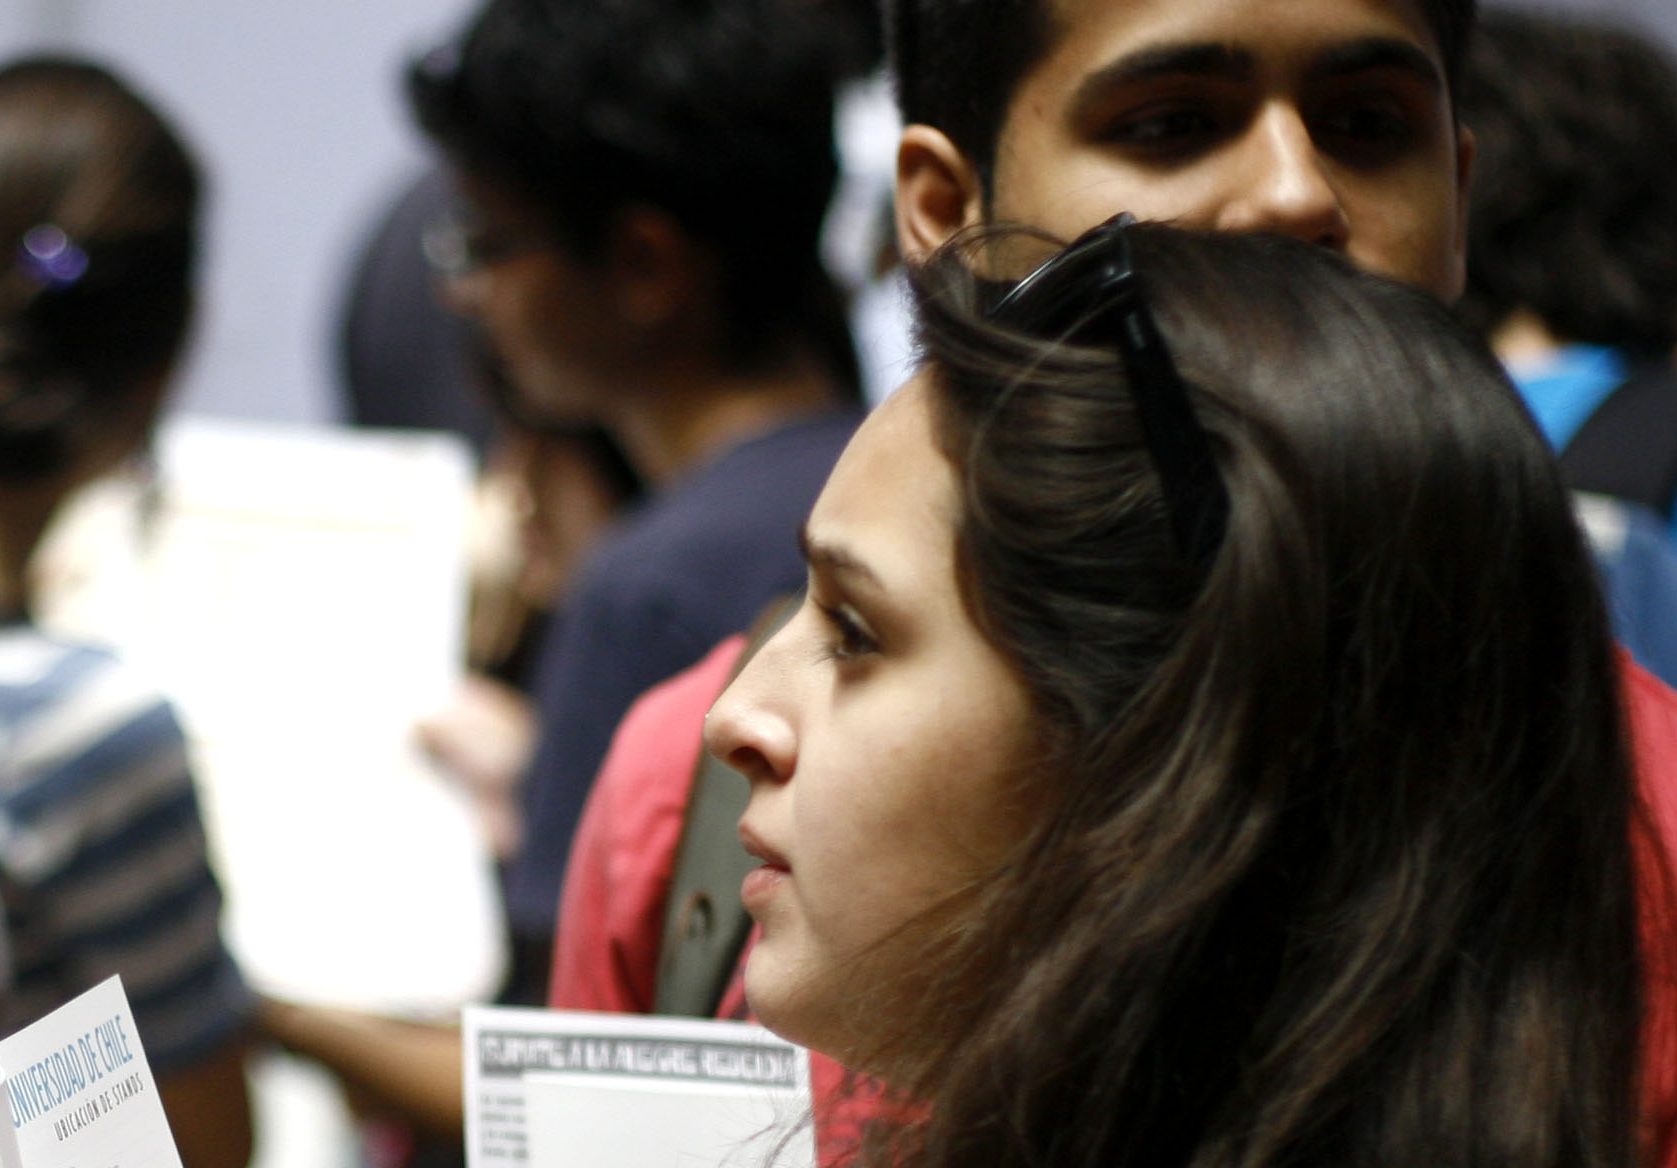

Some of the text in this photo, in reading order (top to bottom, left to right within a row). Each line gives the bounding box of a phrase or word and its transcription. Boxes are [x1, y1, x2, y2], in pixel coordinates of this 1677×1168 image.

[77, 1032, 103, 1084] DE
[94, 1014, 133, 1073] CHILE
[99, 1090, 114, 1114] DE
[111, 1072, 144, 1106] STANDS
